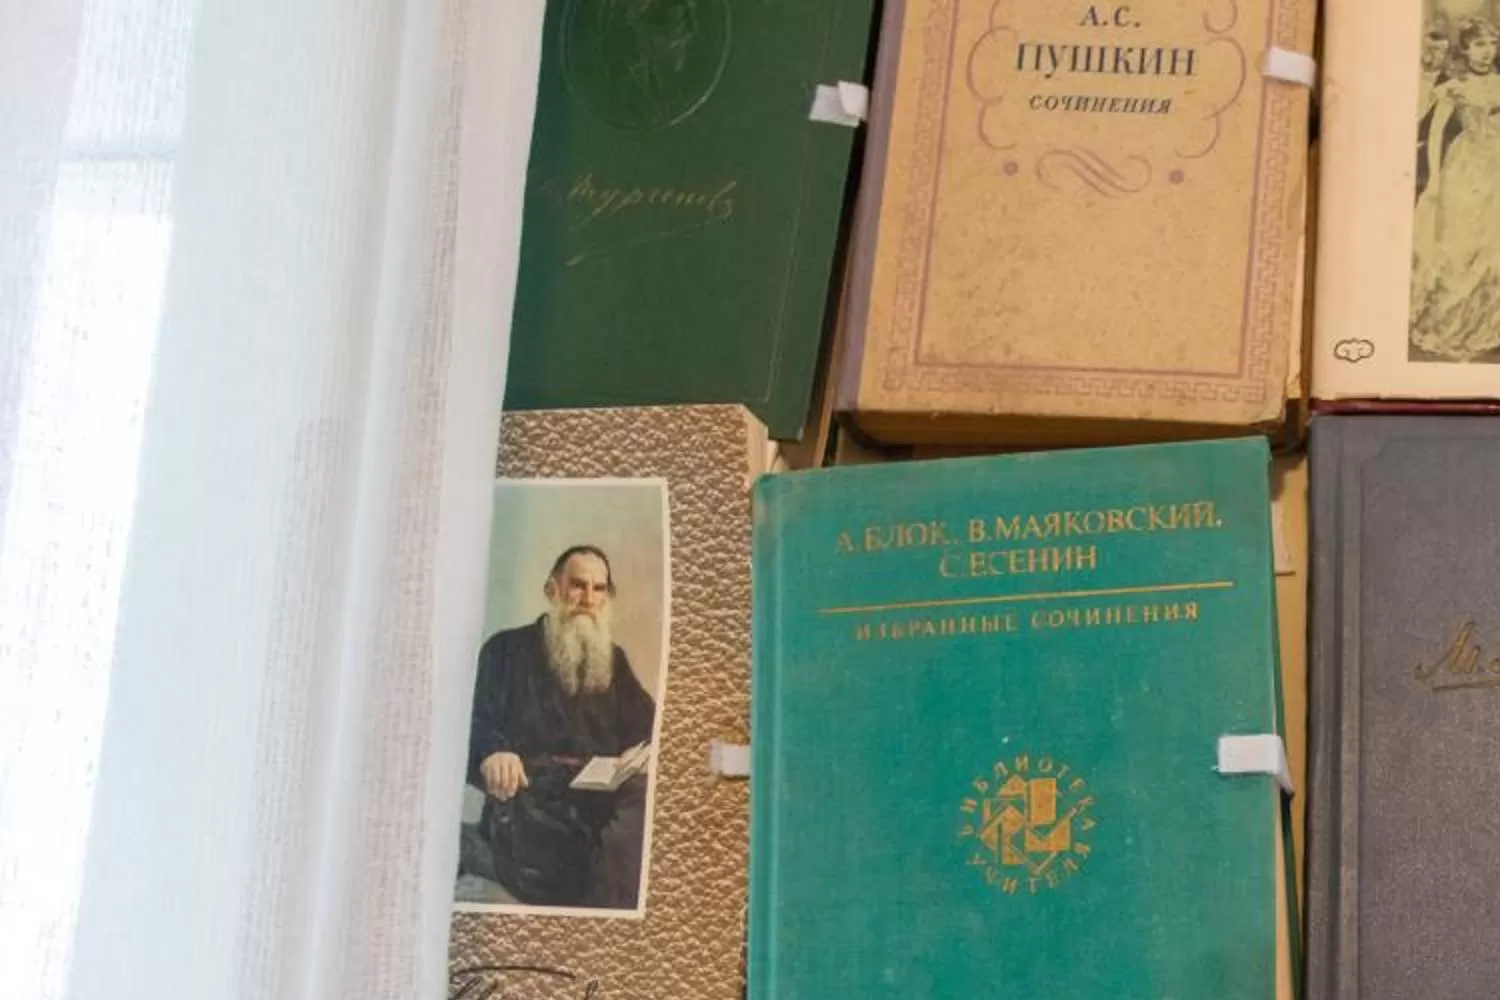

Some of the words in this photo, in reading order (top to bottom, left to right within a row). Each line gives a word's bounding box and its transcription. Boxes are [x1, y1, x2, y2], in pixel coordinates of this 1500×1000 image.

[1079, 5, 1142, 28] А.С.
[1014, 42, 1198, 79] ПУШКИН
[1028, 93, 1173, 115] СОЧИНЕНИЯ
[856, 611, 1020, 641] ИЗБРАННЫЕ
[1030, 600, 1200, 630] СОЧИНЕНИЯ
